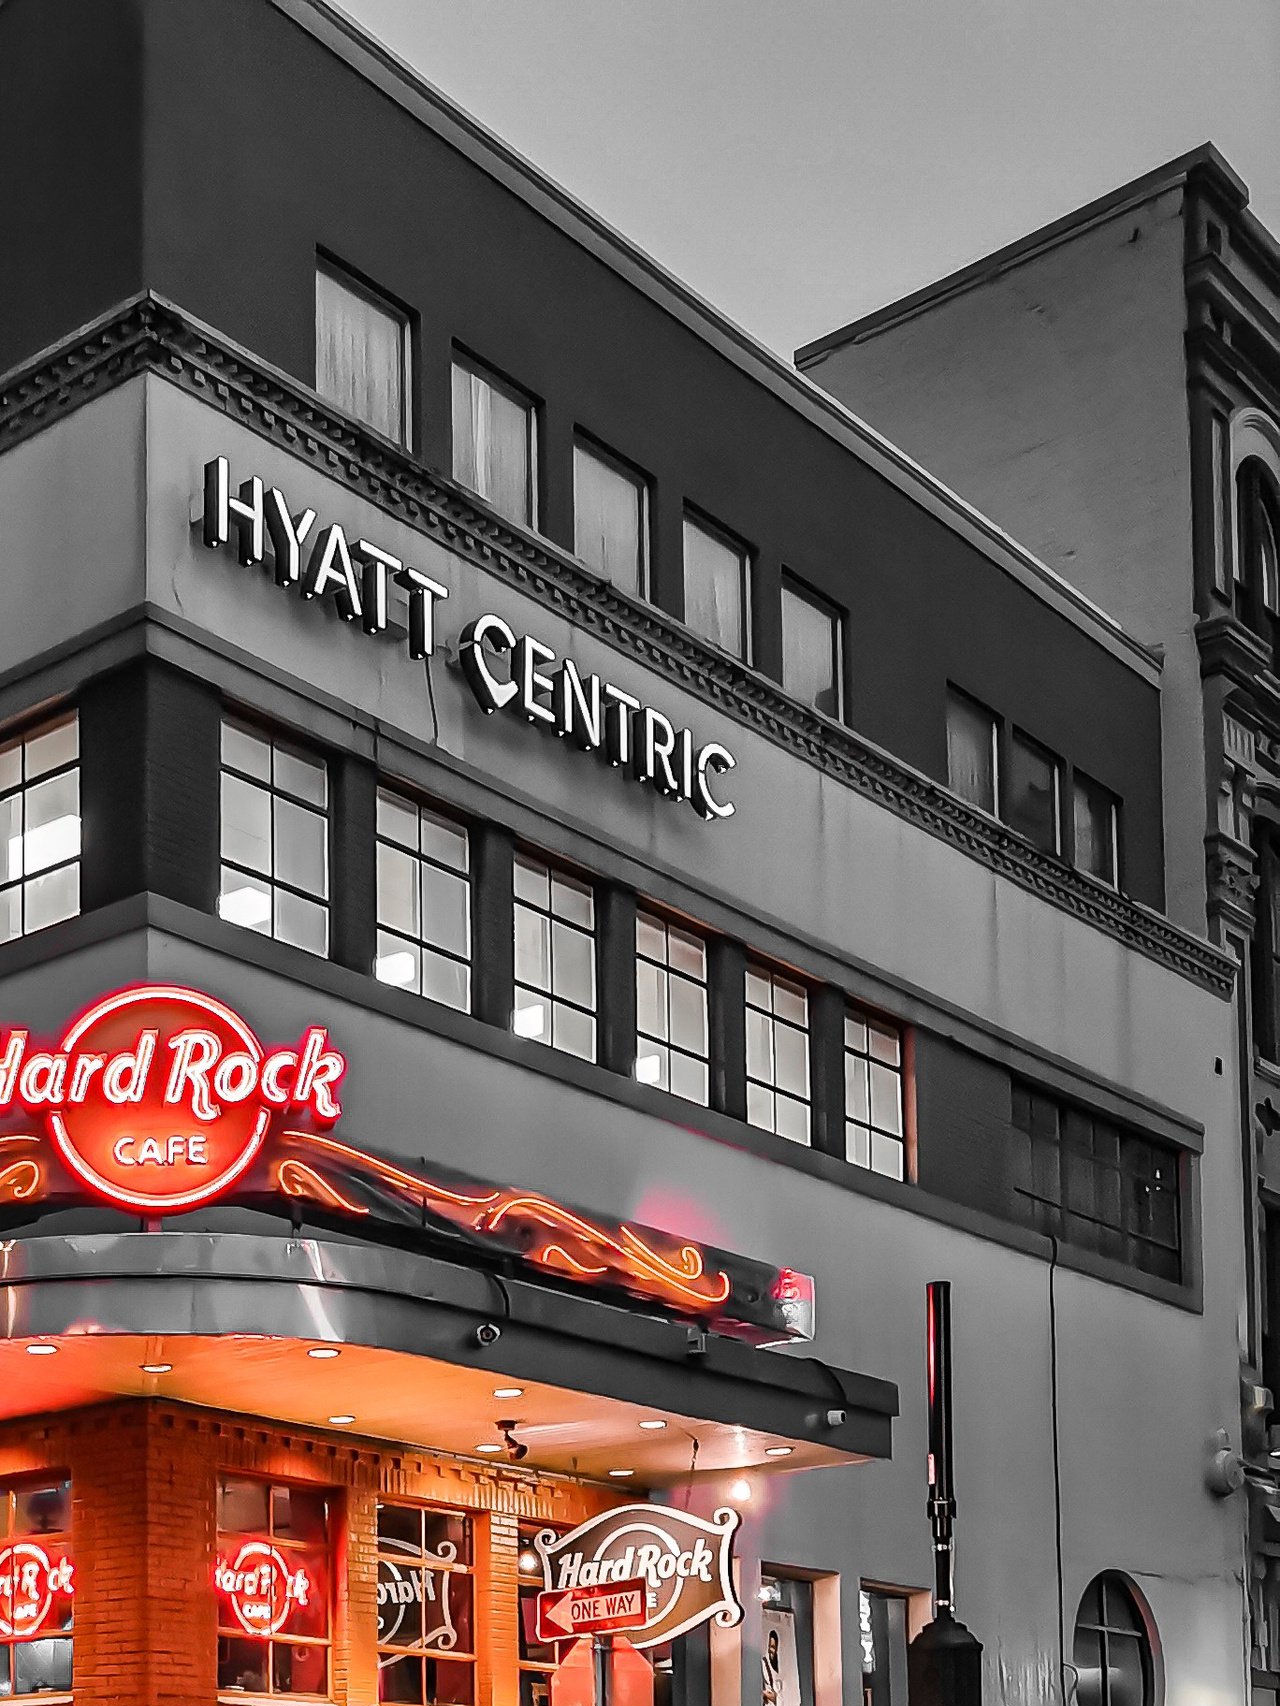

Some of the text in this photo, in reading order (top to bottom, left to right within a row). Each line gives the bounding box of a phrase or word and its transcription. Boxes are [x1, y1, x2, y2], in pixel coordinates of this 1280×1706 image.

[204, 455, 736, 820] HYATT CENTRIC
[165, 1028, 345, 1121] Rock
[113, 1134, 210, 1166] CAFE
[21, 1556, 75, 1600] Rck
[557, 1538, 713, 1589] Hard Rock
[571, 1599, 601, 1620] ONE
[605, 1593, 635, 1616] WAY
